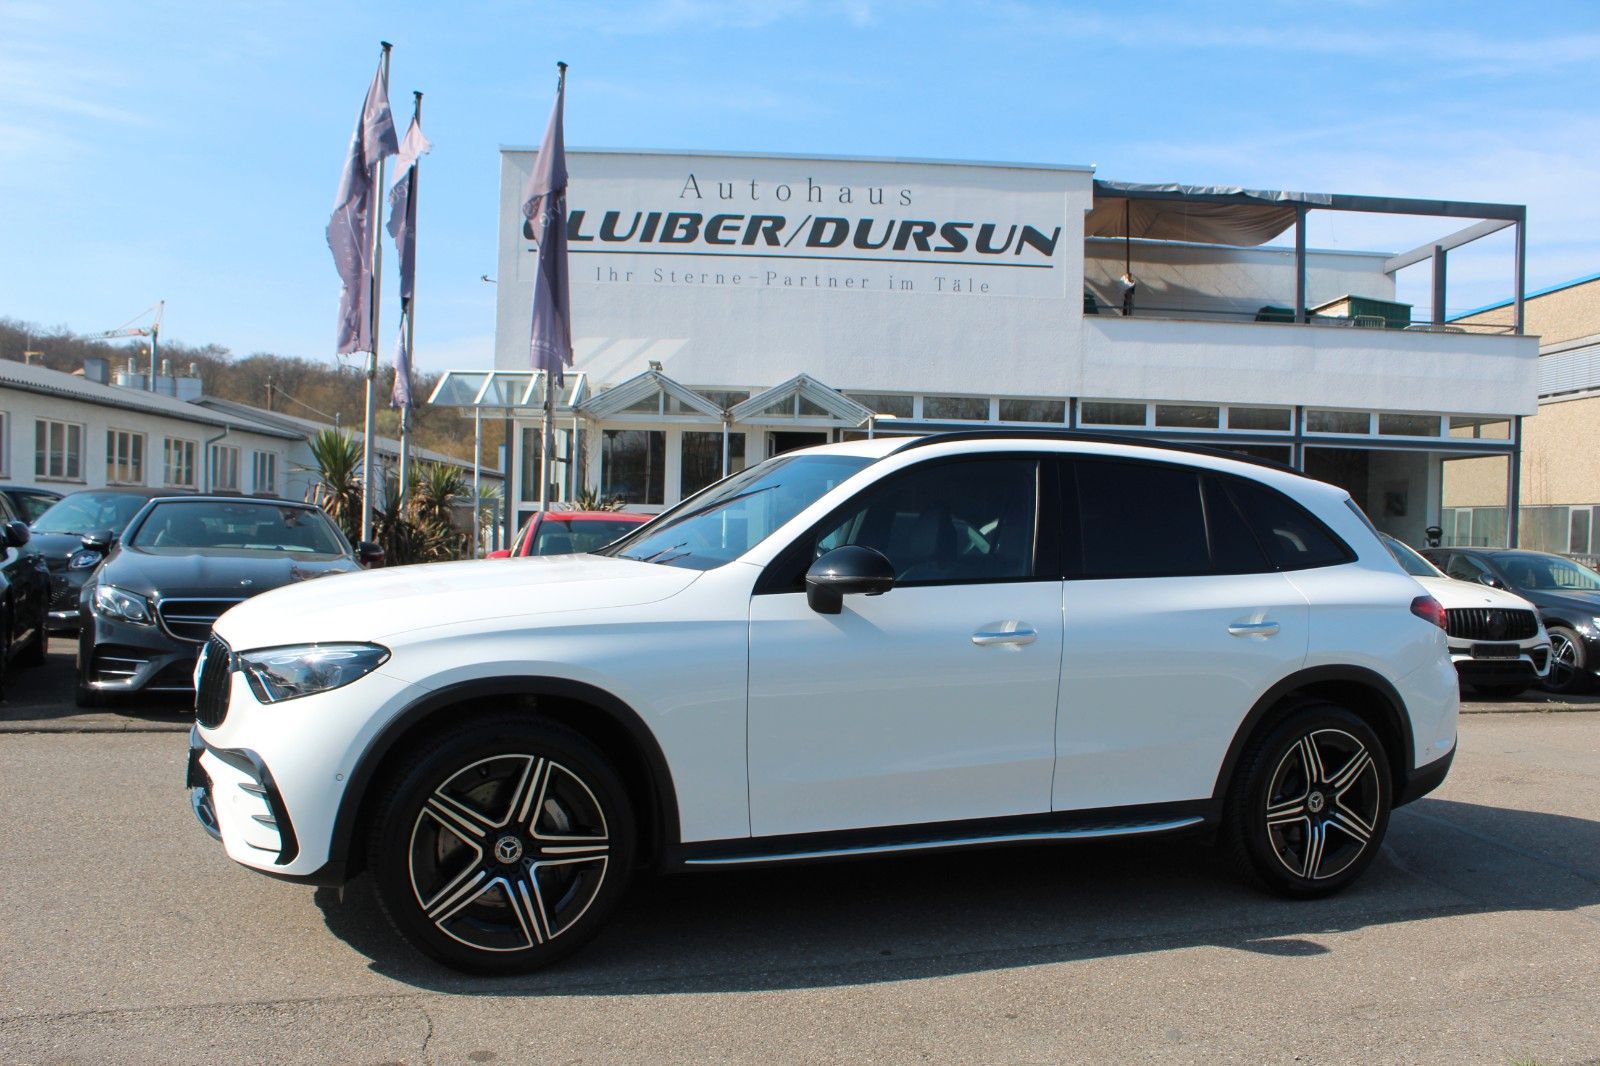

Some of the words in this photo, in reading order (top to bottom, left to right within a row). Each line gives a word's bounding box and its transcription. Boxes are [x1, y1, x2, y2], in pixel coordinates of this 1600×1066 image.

[679, 173, 913, 206] Autohaus
[595, 266, 634, 283] Ihr
[653, 267, 869, 289] Sterne-Partner
[888, 275, 914, 291] im
[934, 275, 990, 293] Täle
